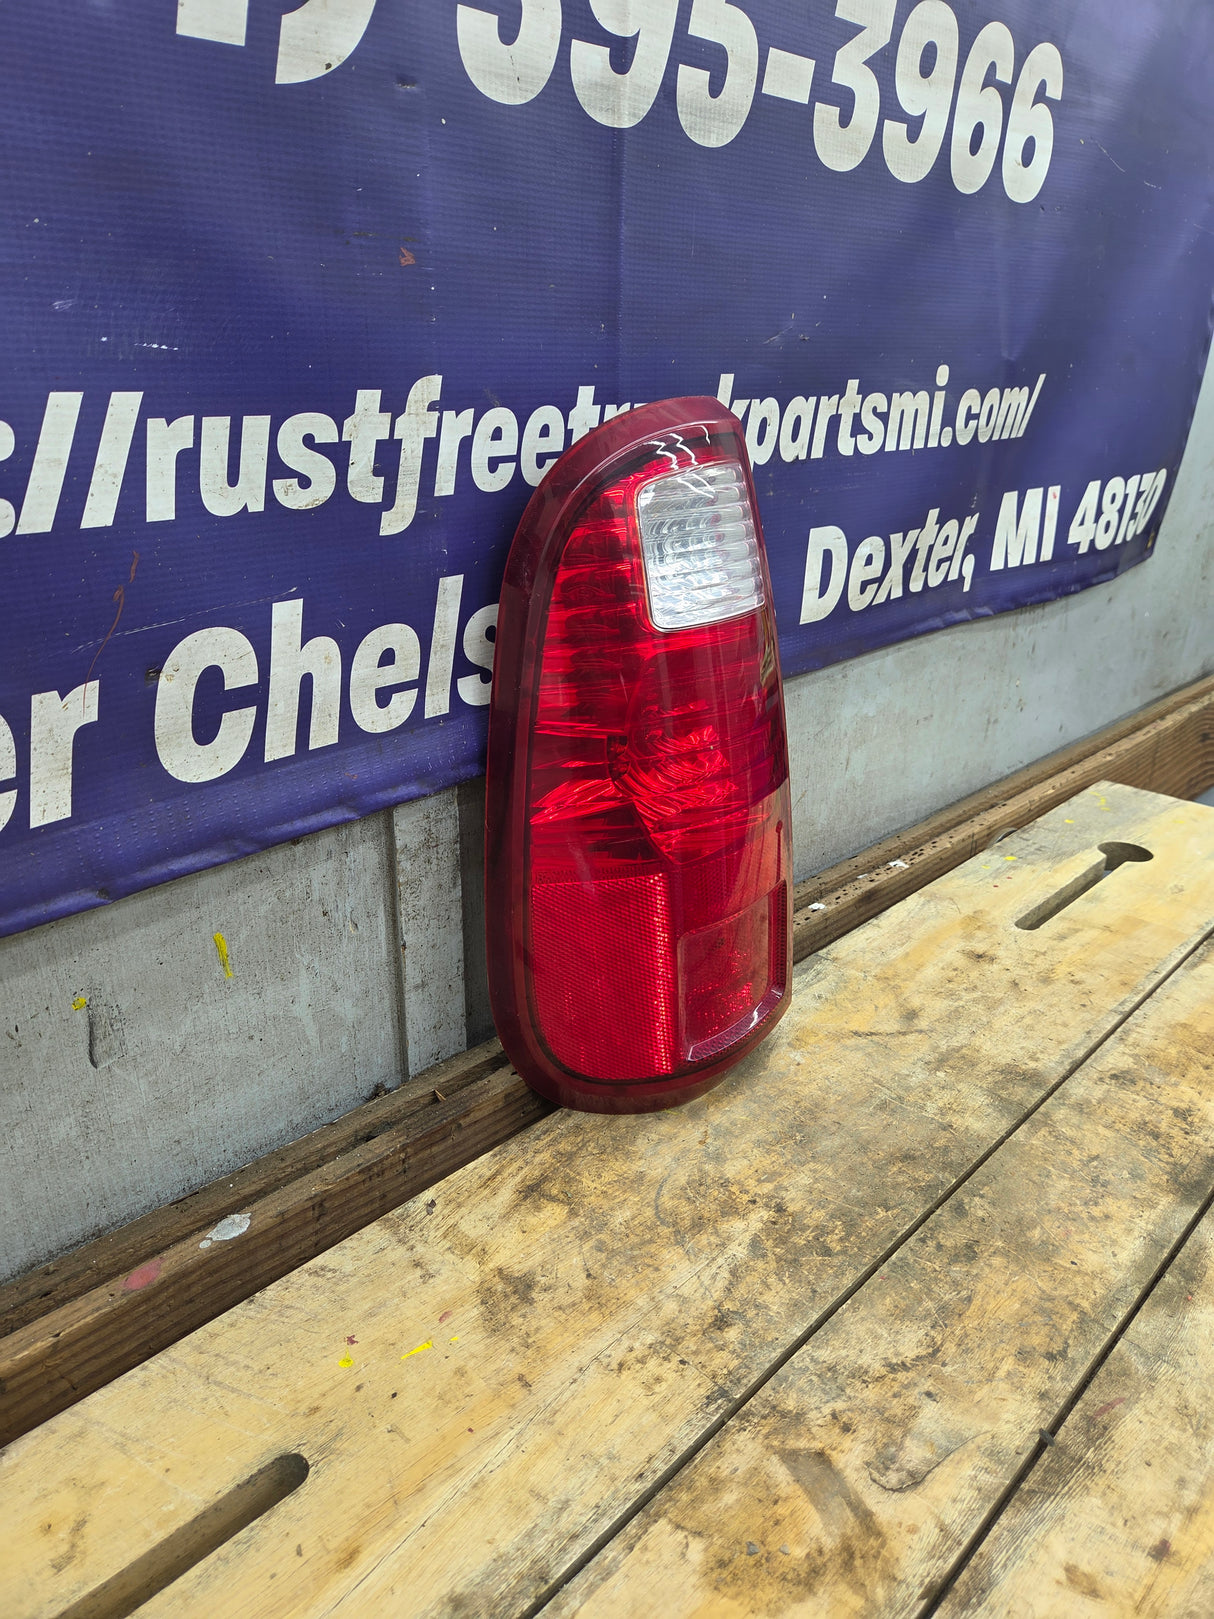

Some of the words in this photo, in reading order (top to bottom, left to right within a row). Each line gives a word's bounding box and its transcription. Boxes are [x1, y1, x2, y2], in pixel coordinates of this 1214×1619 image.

[0, 365, 1046, 538] //rustfreetpartsmi.com/
[799, 507, 979, 625] Dexter,
[990, 485, 1062, 572] MI
[1067, 468, 1168, 554] 48130
